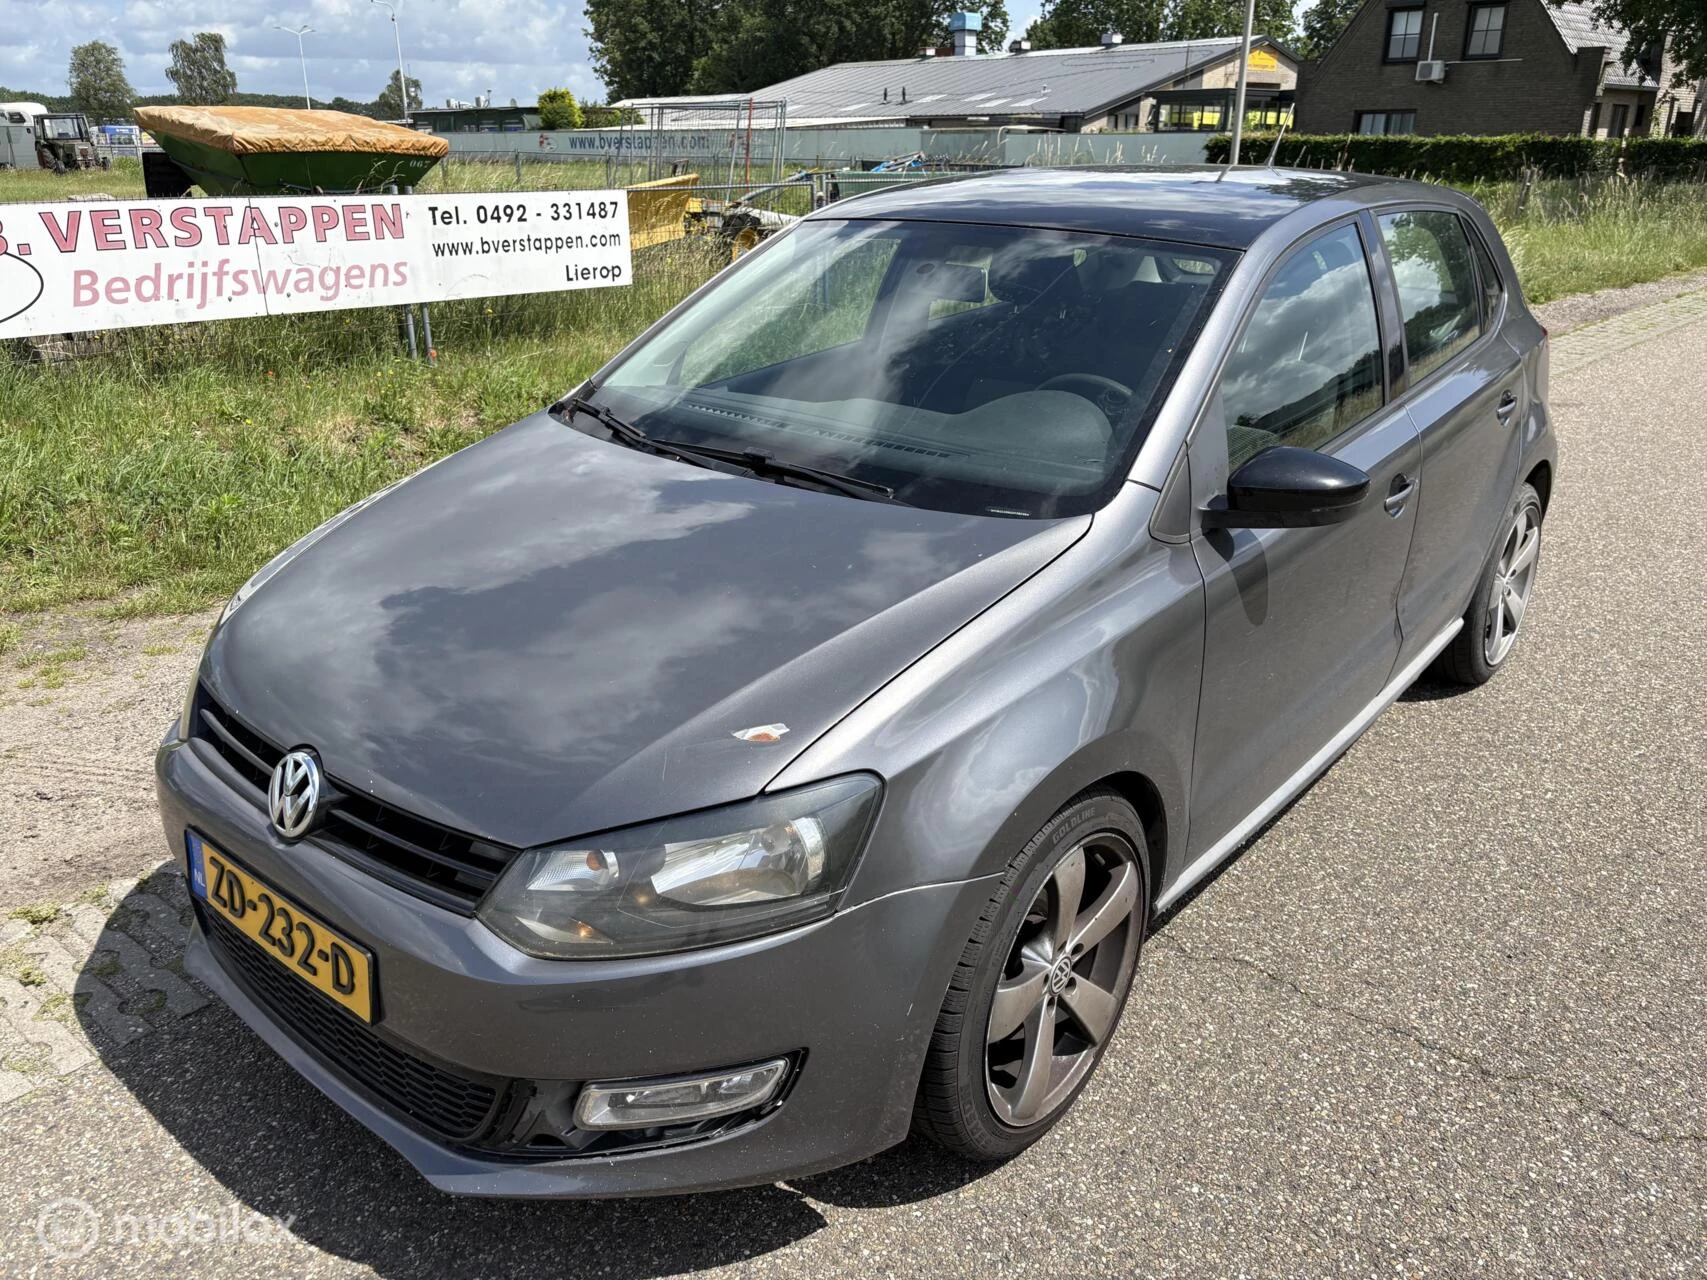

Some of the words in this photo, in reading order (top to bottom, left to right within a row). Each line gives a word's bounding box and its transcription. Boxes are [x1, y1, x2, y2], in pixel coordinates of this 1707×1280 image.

[567, 132, 711, 150] www.bverstapen.com
[428, 205, 467, 226] Tel.
[476, 203, 528, 225] 0492
[550, 201, 619, 222] 331487
[38, 203, 405, 253] VERSTAPPEN
[432, 233, 622, 257] www.bverstappen.com
[72, 258, 409, 310] Bedrijfswagens
[565, 264, 622, 283] Lierop
[194, 867, 206, 888] NL
[209, 855, 356, 996] ZD-232-D
